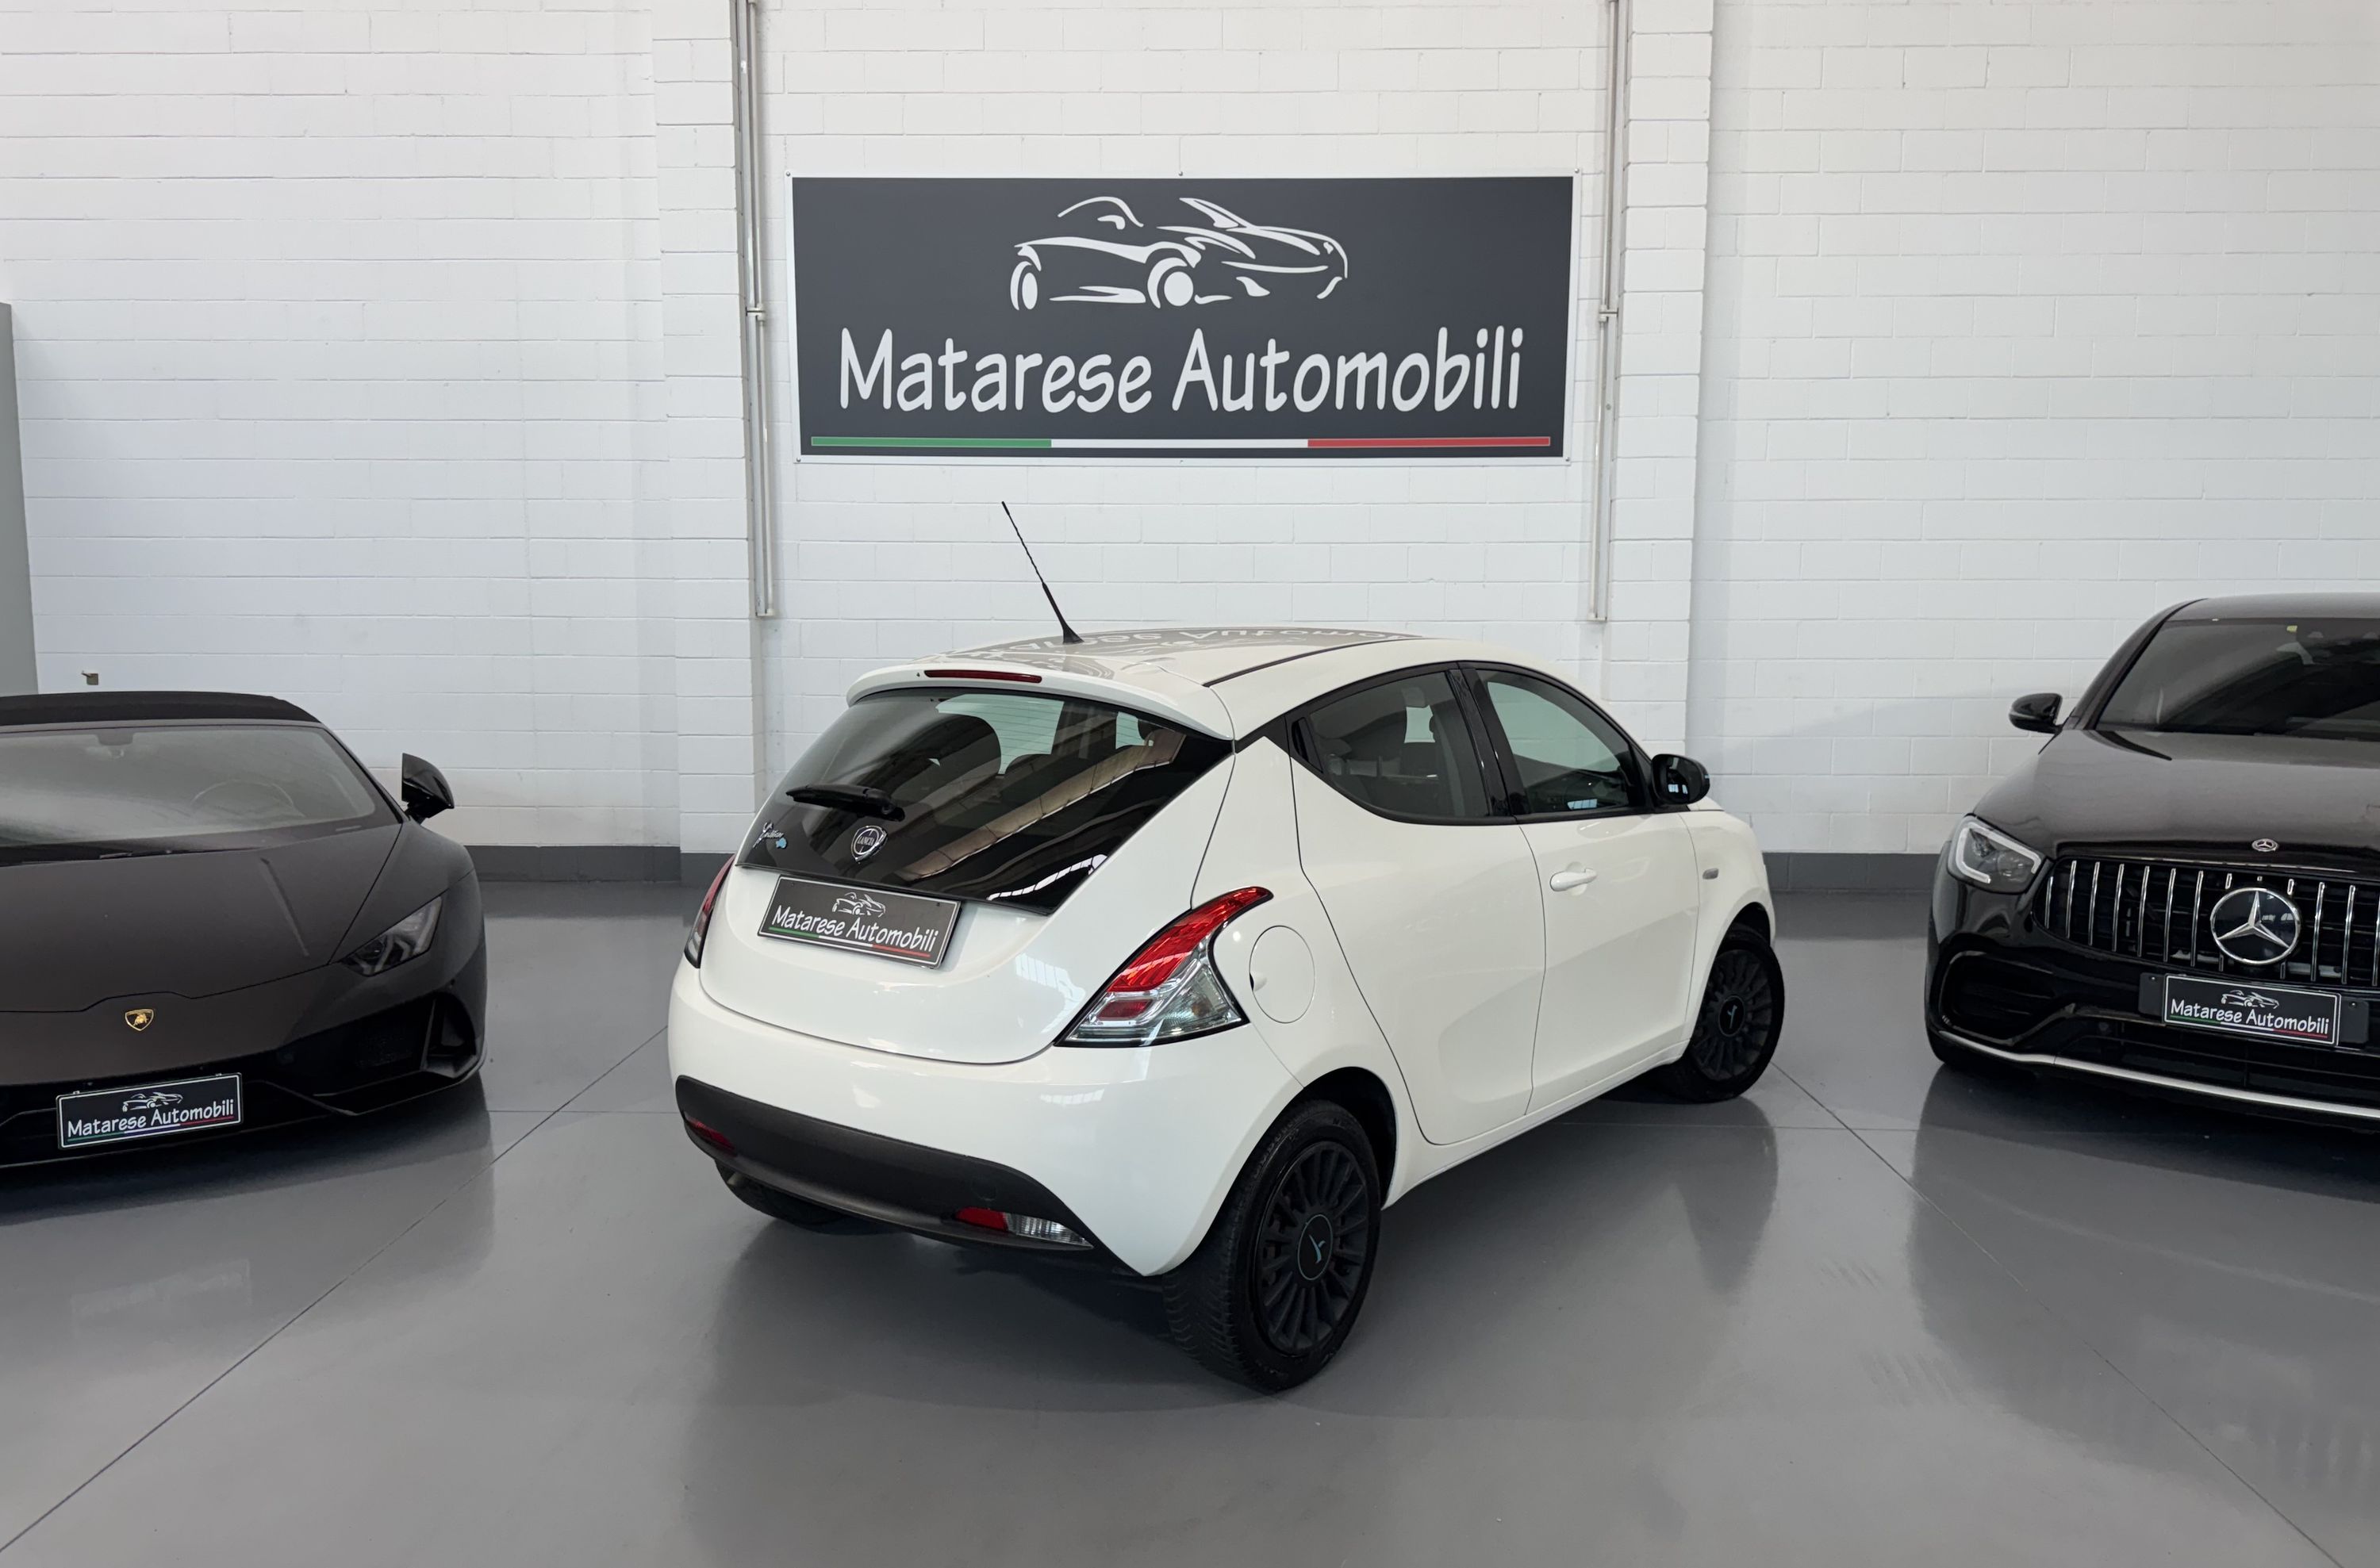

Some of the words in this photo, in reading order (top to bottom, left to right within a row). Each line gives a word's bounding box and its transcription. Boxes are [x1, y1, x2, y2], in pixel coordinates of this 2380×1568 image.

[840, 327, 1152, 413] Matarese
[1172, 325, 1523, 412] Automobili
[771, 905, 846, 937] Matarese
[846, 917, 939, 953] Automobili
[2171, 998, 2243, 1023] Matarese
[2245, 1008, 2329, 1035] Automobili
[67, 1115, 147, 1137] Matarese
[150, 1098, 234, 1126] Automobili
